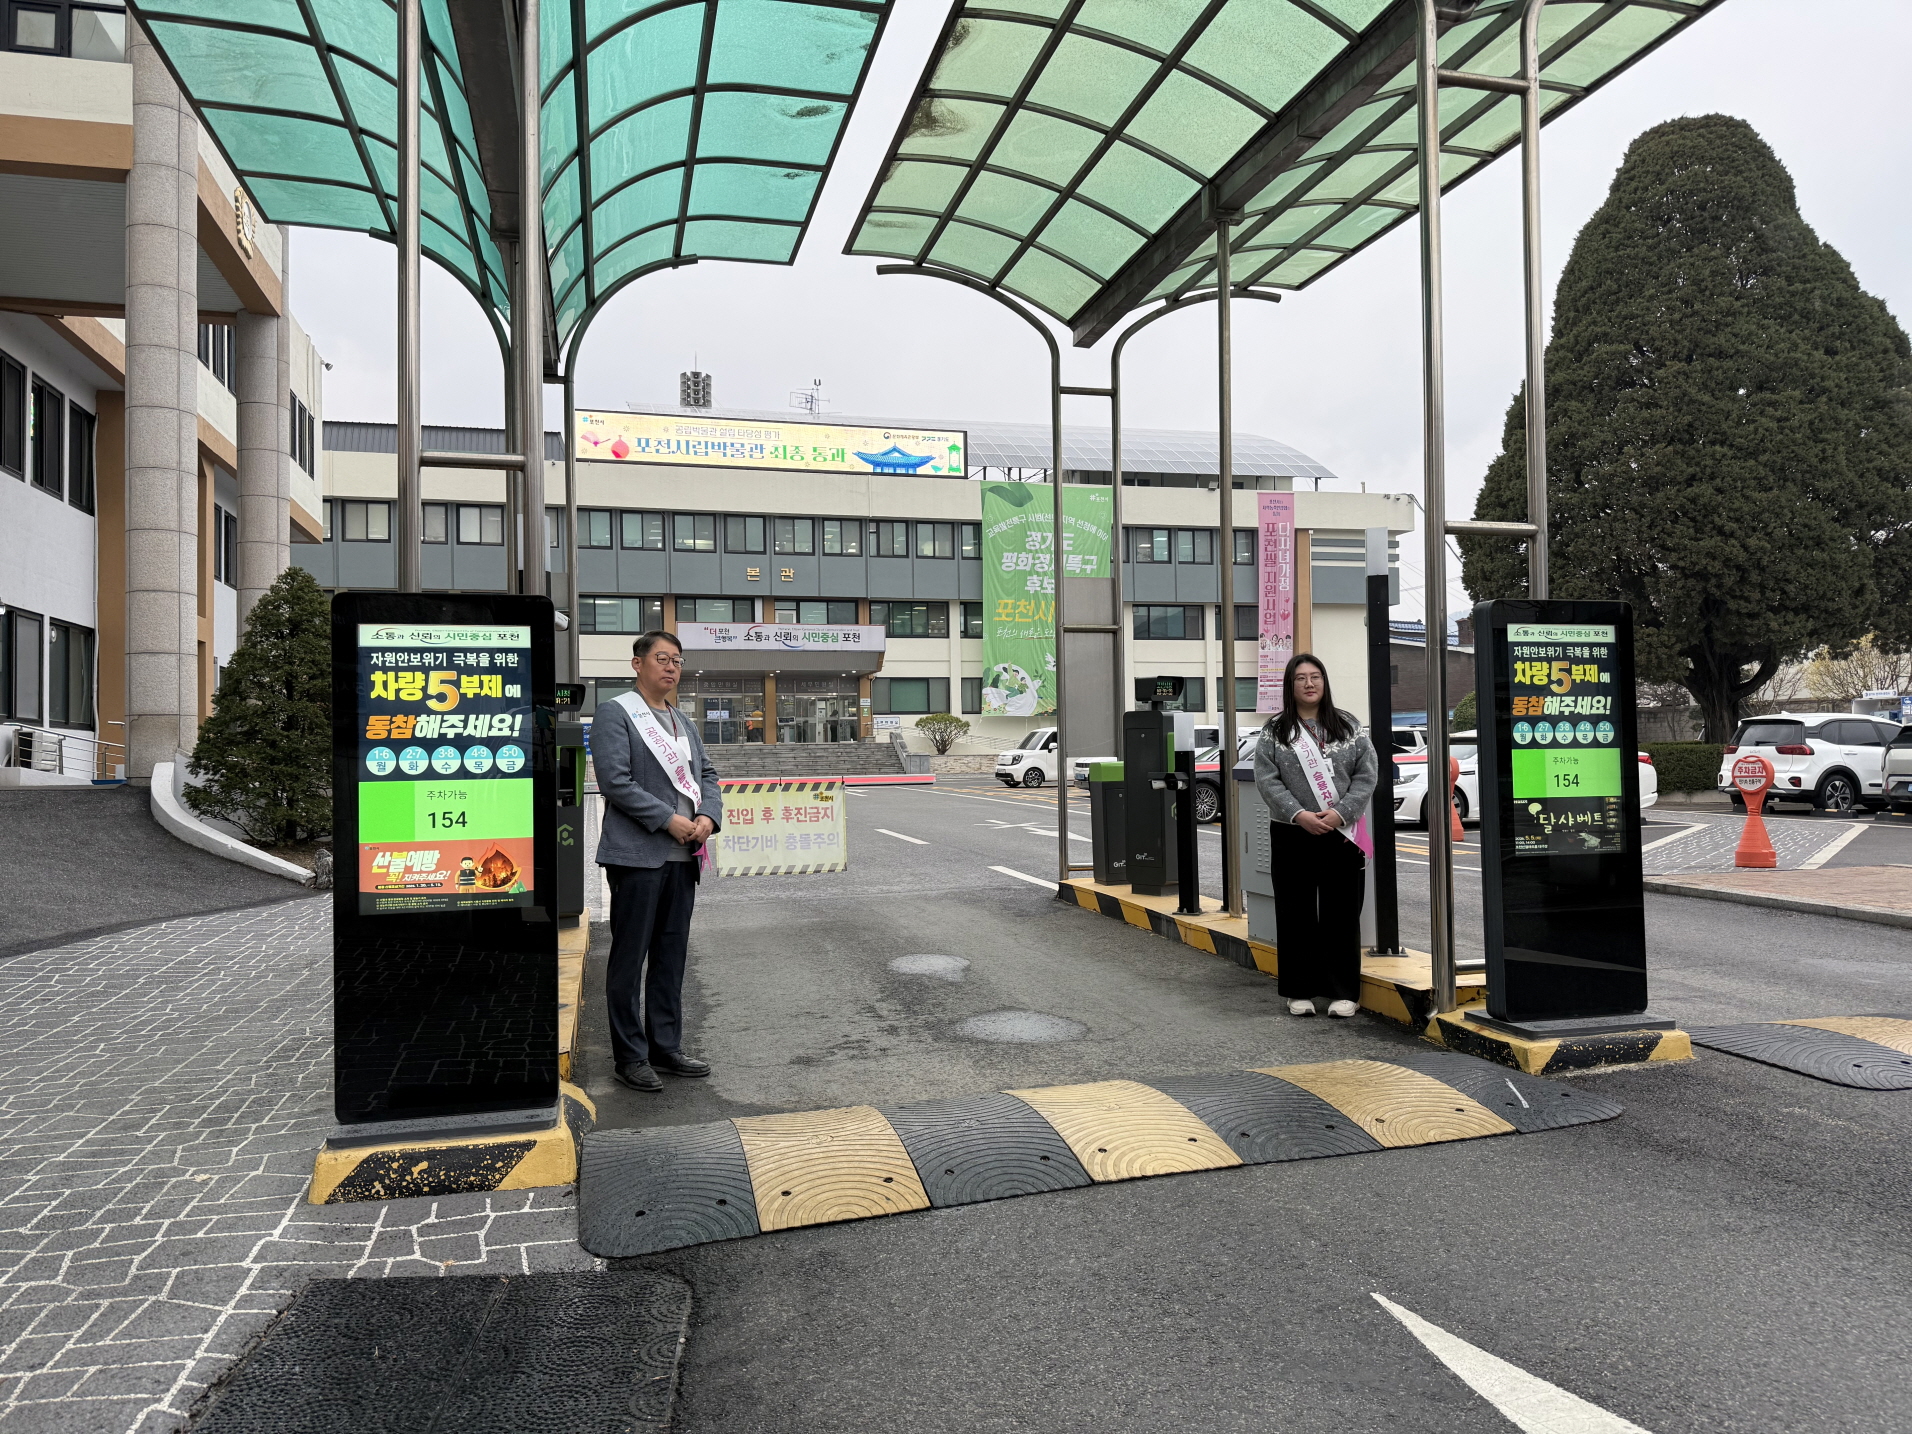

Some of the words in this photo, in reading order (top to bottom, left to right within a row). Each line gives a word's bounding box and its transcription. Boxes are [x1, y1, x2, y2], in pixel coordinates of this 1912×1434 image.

[675, 424, 717, 436] 공립박물관
[719, 426, 735, 437] 설립
[737, 427, 762, 439] 타당성
[764, 429, 780, 440] 평가
[635, 437, 766, 459] 포천시립박물관
[770, 444, 806, 462] 최종
[812, 446, 847, 463] 통과
[1264, 522, 1277, 568] 포천쌀
[1279, 521, 1291, 591] 다자녀가정
[1264, 571, 1277, 625] 지원사업
[993, 599, 1055, 623] 포천시
[371, 631, 405, 641] 소통과
[408, 631, 441, 641] 신뢰의
[444, 632, 492, 641] 시민중심
[496, 632, 520, 642] 포천
[743, 631, 770, 642] 소통과
[773, 632, 799, 642] 신뢰의
[801, 632, 839, 643] 시민중심
[841, 632, 861, 643] 포천
[1513, 629, 1535, 637] 소통과
[1537, 629, 1558, 637] 신뢰의
[1560, 630, 1591, 638] 시민중심
[1593, 630, 1609, 638] 포천
[370, 652, 447, 667] 자원안보위기
[452, 652, 491, 667] 극복을
[494, 653, 519, 667] 위한
[1513, 646, 1563, 658] 자원안보위기
[1565, 646, 1590, 658] 극복을
[1592, 646, 1608, 658] 위한
[1512, 695, 1612, 716] 동참해주세요!
[365, 713, 523, 739] 동참해주세요!
[645, 726, 680, 765] 공공기관
[1519, 733, 1527, 742] 월
[1540, 732, 1548, 742] 화
[1561, 734, 1569, 742] 수
[1581, 733, 1589, 742] 목
[1601, 733, 1609, 742] 금
[376, 761, 387, 773] 월
[408, 760, 420, 772] 화
[440, 761, 452, 772] 수
[473, 760, 484, 772] 목
[505, 760, 517, 771] 금
[1552, 756, 1579, 765] 주차가능
[1737, 766, 1764, 775] 주차금지
[1312, 771, 1333, 801] 승용차
[1553, 773, 1580, 788] 154
[426, 789, 468, 800] 주차가능
[427, 811, 468, 828] 154
[727, 807, 755, 825] 진입
[760, 806, 775, 824] 후
[780, 805, 835, 823] 후진금지
[1539, 811, 1604, 834] 달샤베트
[723, 833, 779, 852] 차단기바
[784, 831, 840, 851] 충돌주의
[371, 850, 441, 873] 산불예방
[385, 872, 402, 883] 꼭!
[402, 870, 452, 883] 지켜주세요!
